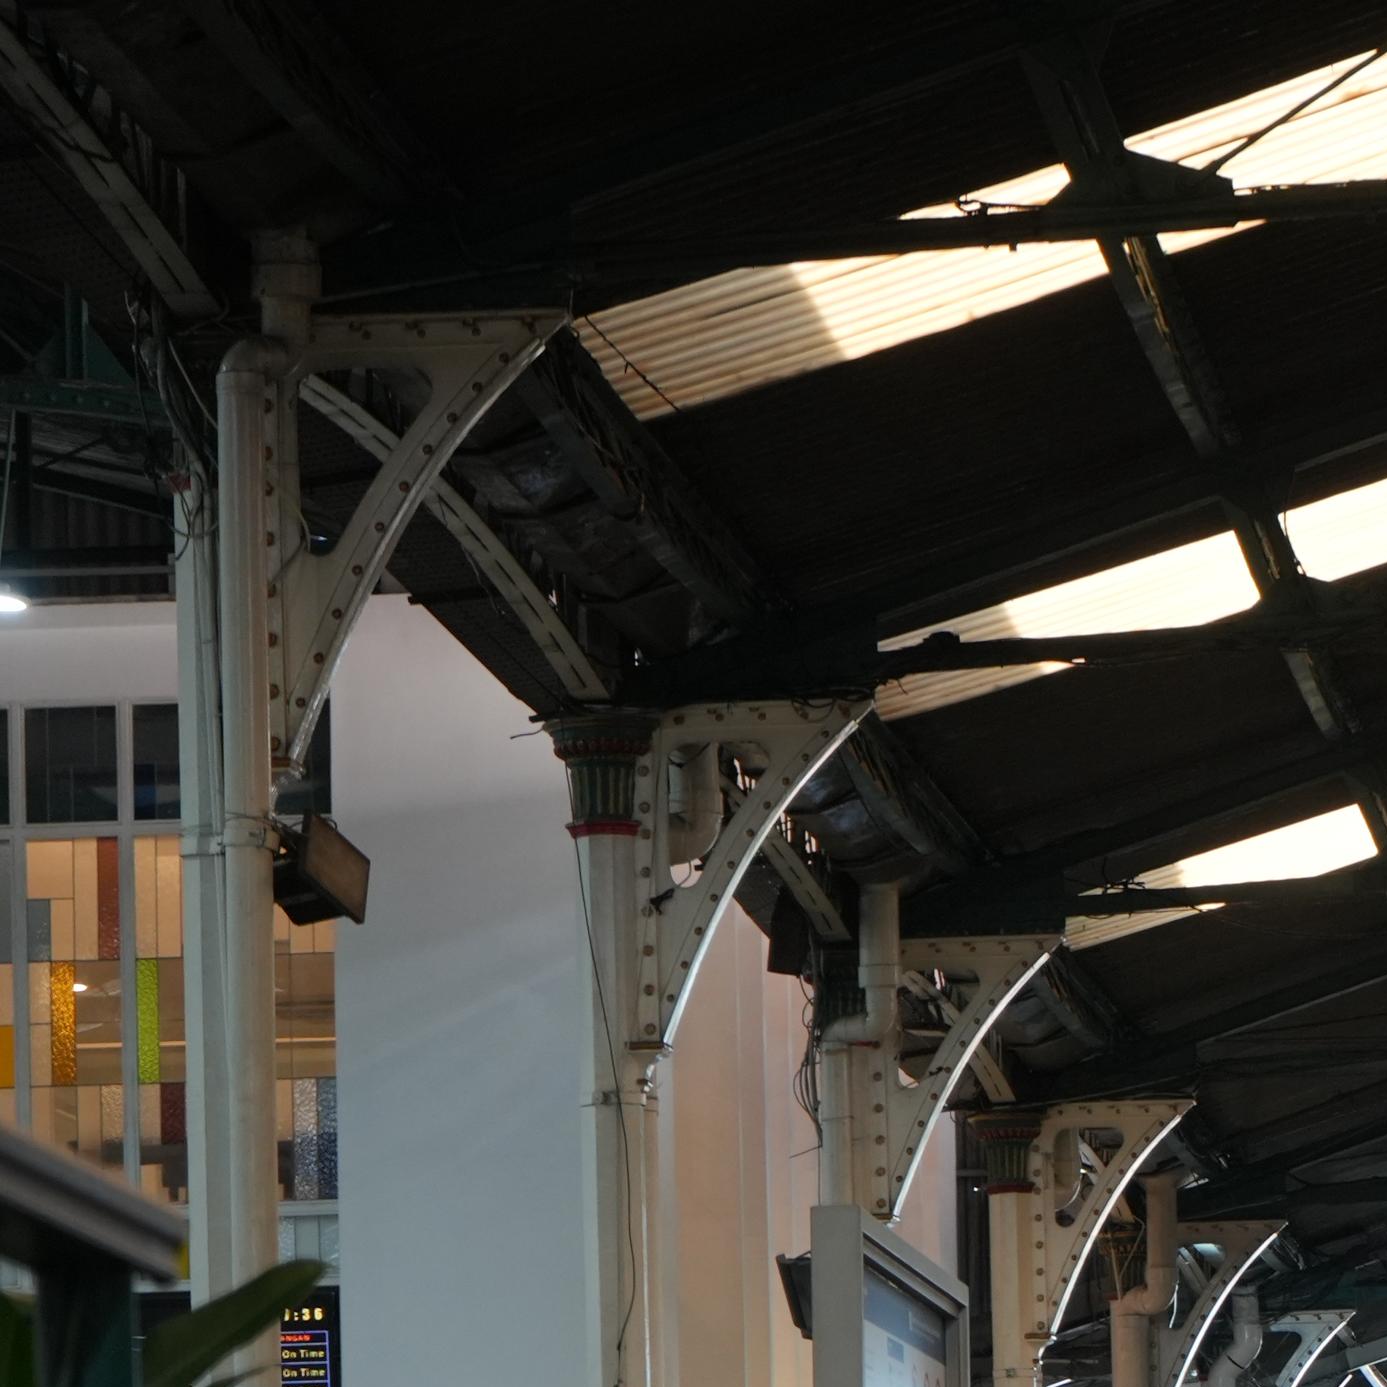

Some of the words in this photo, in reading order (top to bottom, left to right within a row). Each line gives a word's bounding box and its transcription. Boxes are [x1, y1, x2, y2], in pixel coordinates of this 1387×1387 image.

[282, 1348, 297, 1359] On
[300, 1347, 325, 1358] Time
[282, 1367, 298, 1378] On
[301, 1366, 326, 1377] Time
